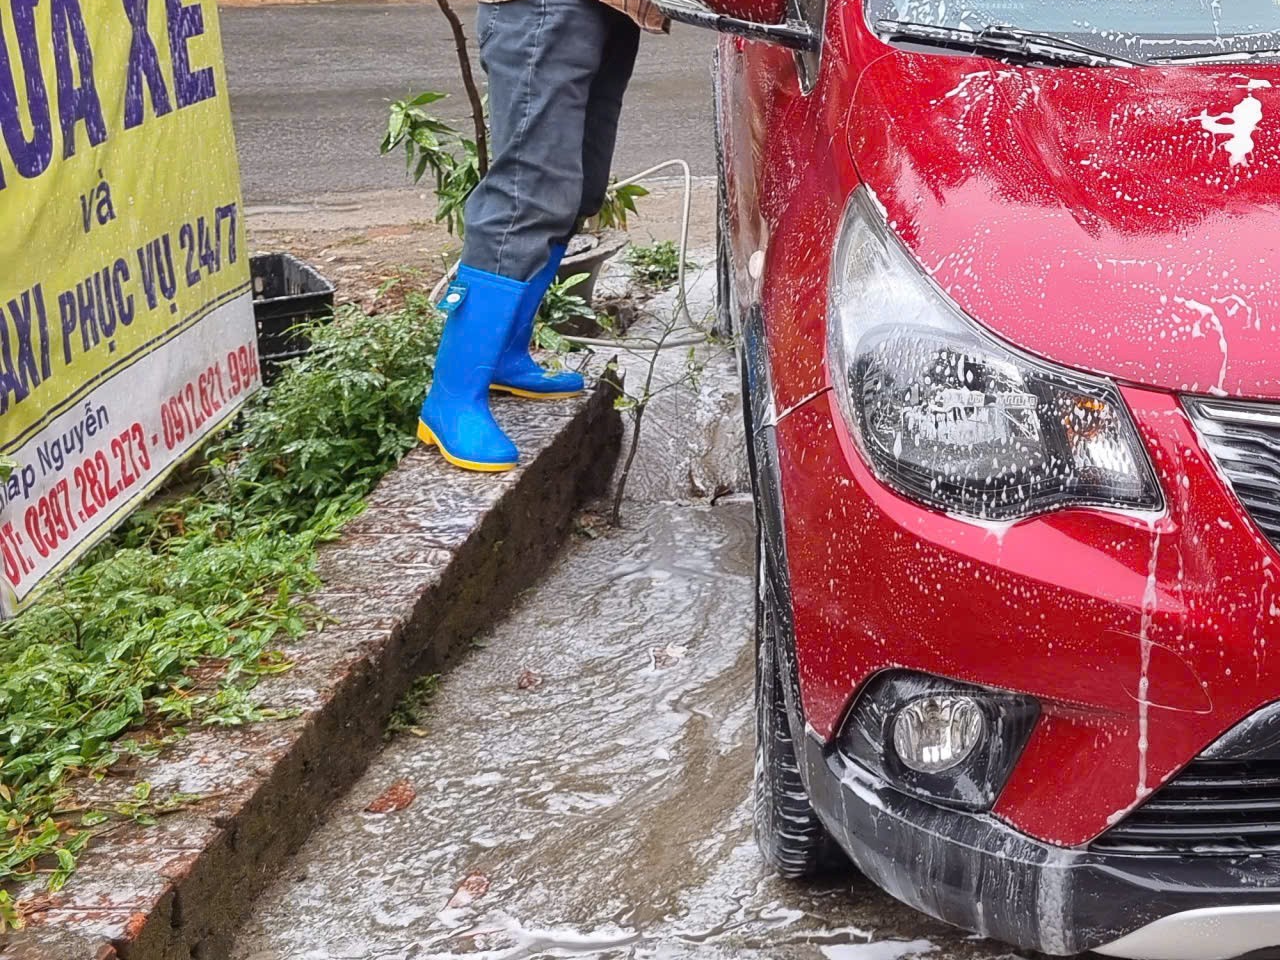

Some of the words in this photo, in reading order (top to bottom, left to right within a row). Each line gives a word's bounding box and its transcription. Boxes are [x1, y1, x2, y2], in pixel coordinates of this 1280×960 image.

[80, 168, 116, 234] và
[58, 258, 134, 365] PHỤC
[137, 233, 177, 315] VỤ
[179, 203, 237, 287] 24/7
[25, 422, 151, 558] 0397.282.273
[161, 341, 258, 450] 0912.621.994
[37, 401, 109, 476] Nguyễn
